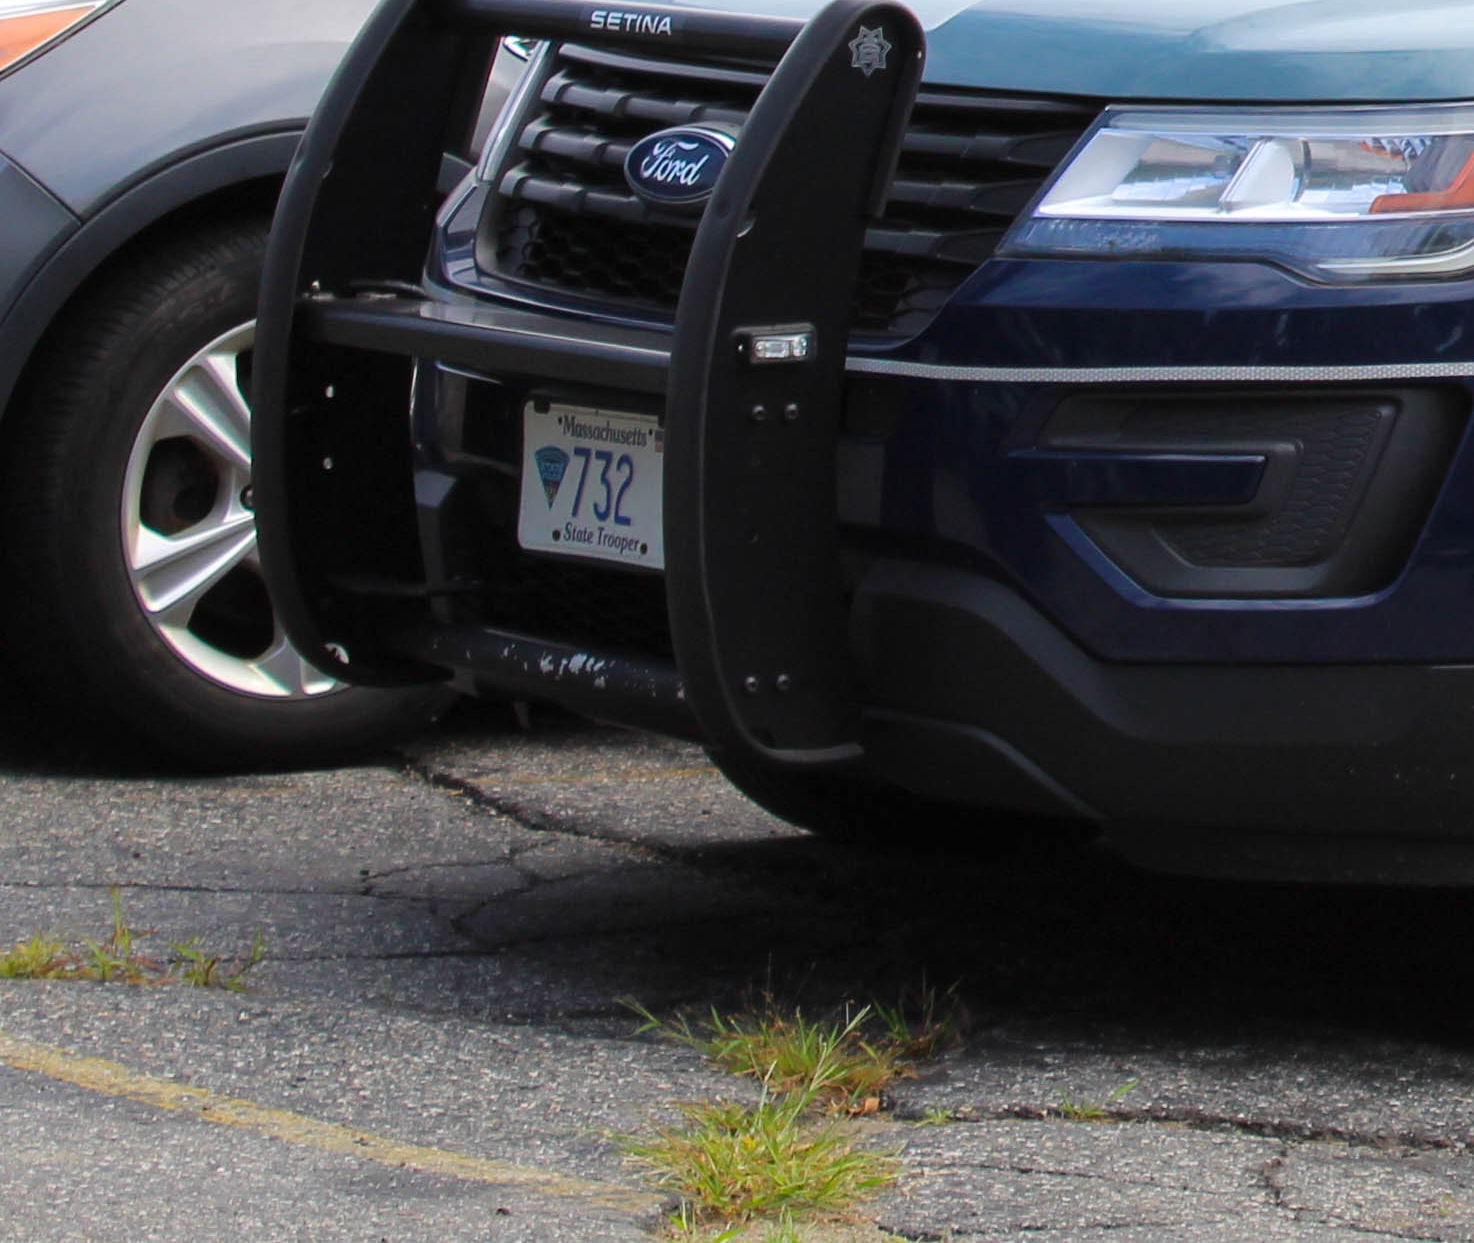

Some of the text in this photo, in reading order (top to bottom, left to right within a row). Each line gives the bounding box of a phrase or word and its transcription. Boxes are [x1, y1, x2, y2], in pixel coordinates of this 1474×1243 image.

[590, 10, 672, 35] SETINA
[640, 138, 709, 186] Ford
[563, 415, 647, 447] Massachusetts
[571, 446, 632, 525] 732
[563, 521, 640, 554] State Trooper
